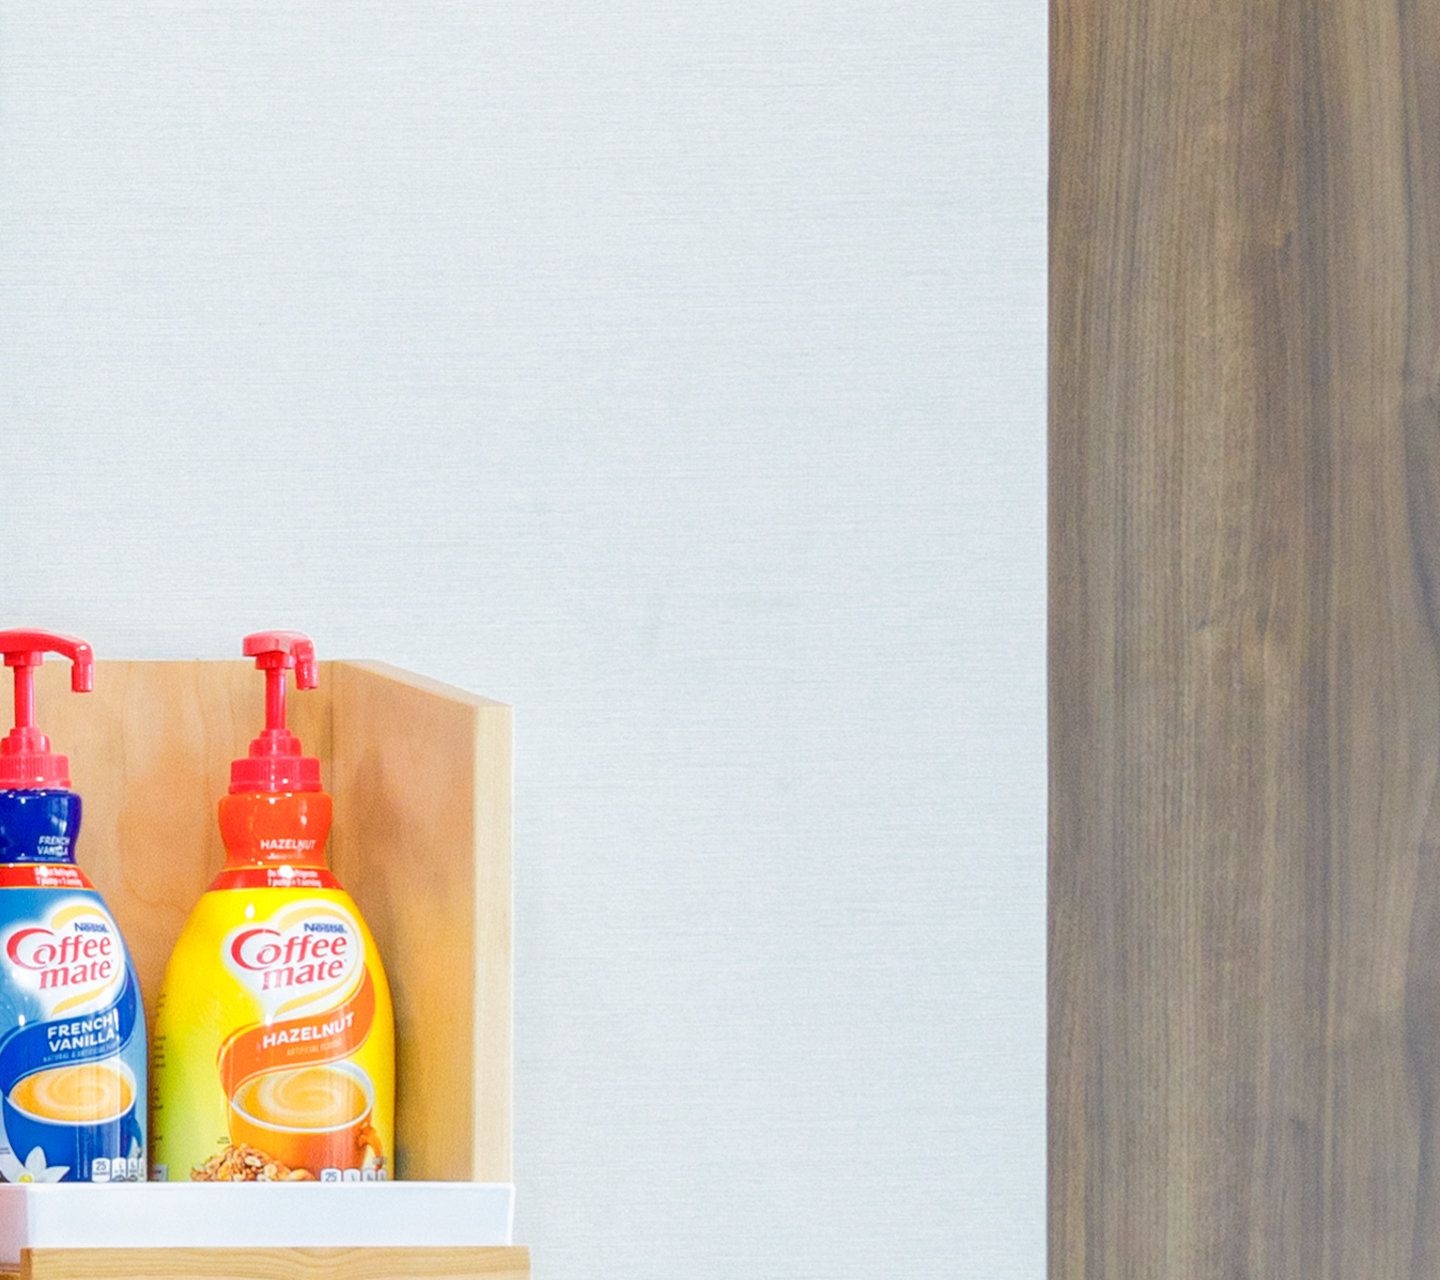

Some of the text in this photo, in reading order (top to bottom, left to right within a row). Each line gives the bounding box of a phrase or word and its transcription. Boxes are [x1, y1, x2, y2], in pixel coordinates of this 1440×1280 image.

[260, 839, 316, 850] HAZELNUT
[6, 928, 111, 970] Coffee
[231, 928, 347, 970] Coffee
[39, 960, 112, 990] mate
[262, 960, 344, 990] mate
[47, 1015, 112, 1040] FRENCH
[48, 1028, 115, 1052] VANILLA
[262, 1012, 355, 1049] HAZELNUT
